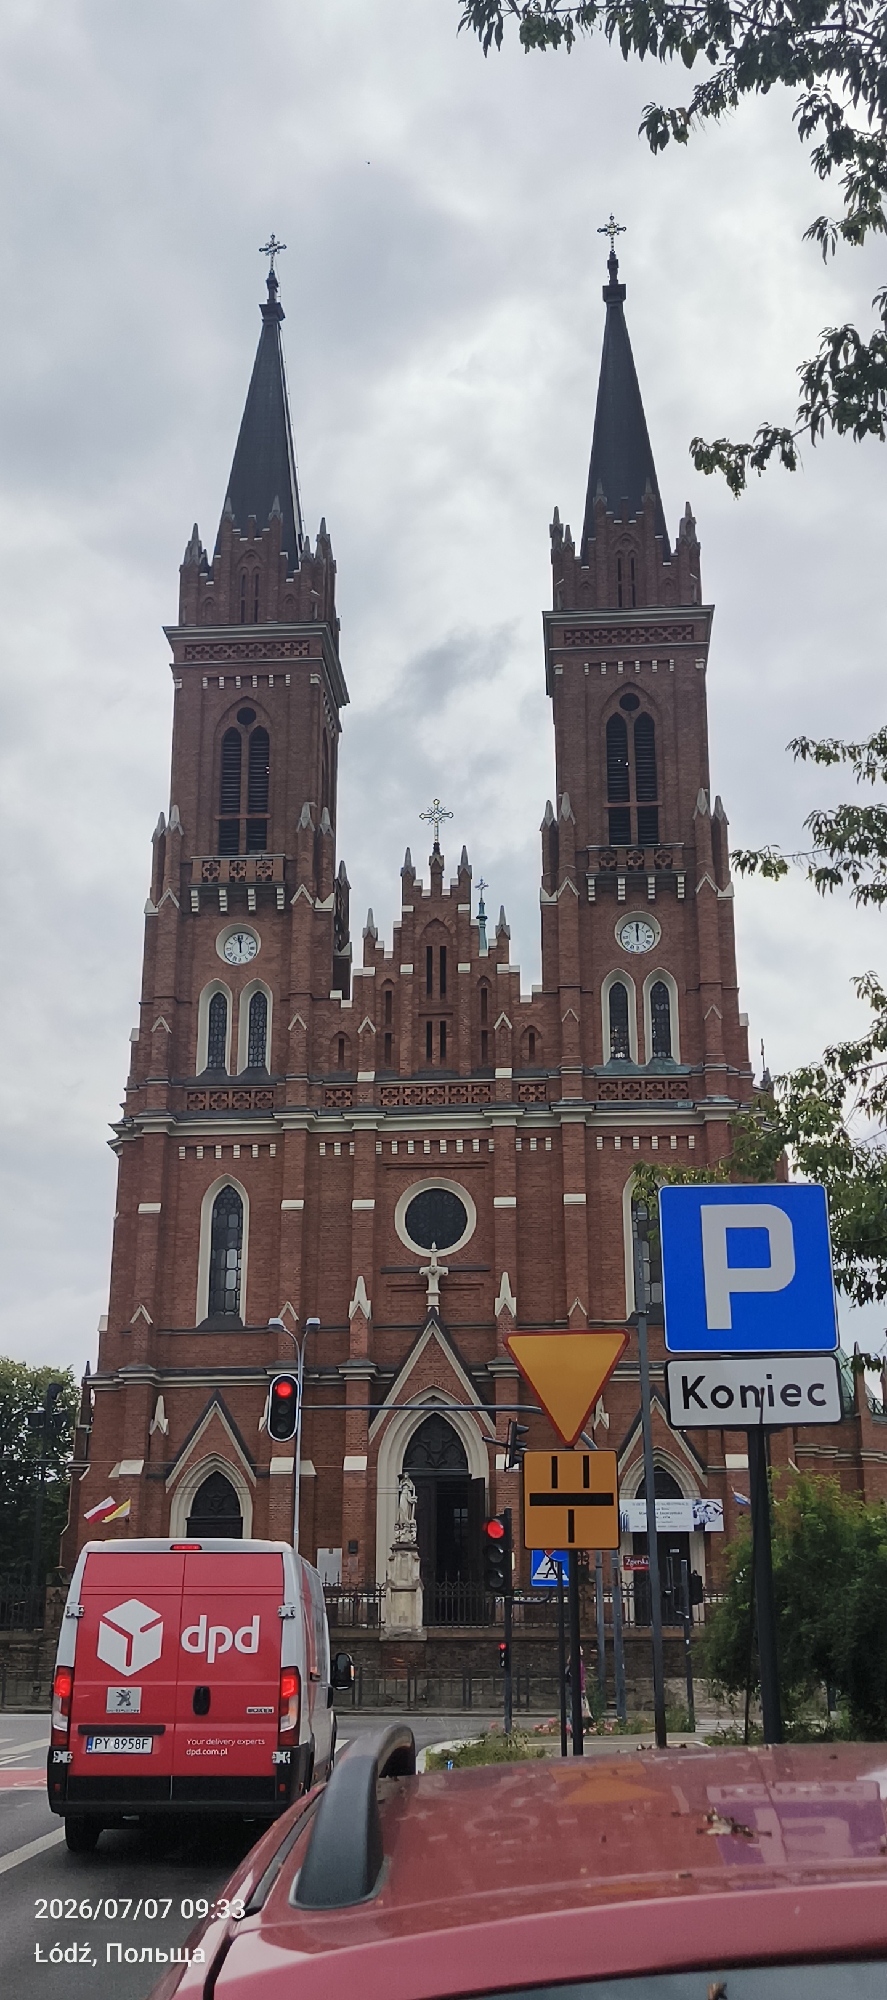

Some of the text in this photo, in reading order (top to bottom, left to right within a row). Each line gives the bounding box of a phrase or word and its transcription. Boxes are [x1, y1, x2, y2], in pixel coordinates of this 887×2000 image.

[700, 1203, 796, 1330] P
[681, 1373, 827, 1410] Koniec
[181, 1614, 260, 1664] dpd
[94, 1738, 149, 1750] PY 8958F
[186, 1747, 228, 1756] dpd.com.pl
[206, 1738, 235, 1747] delivery
